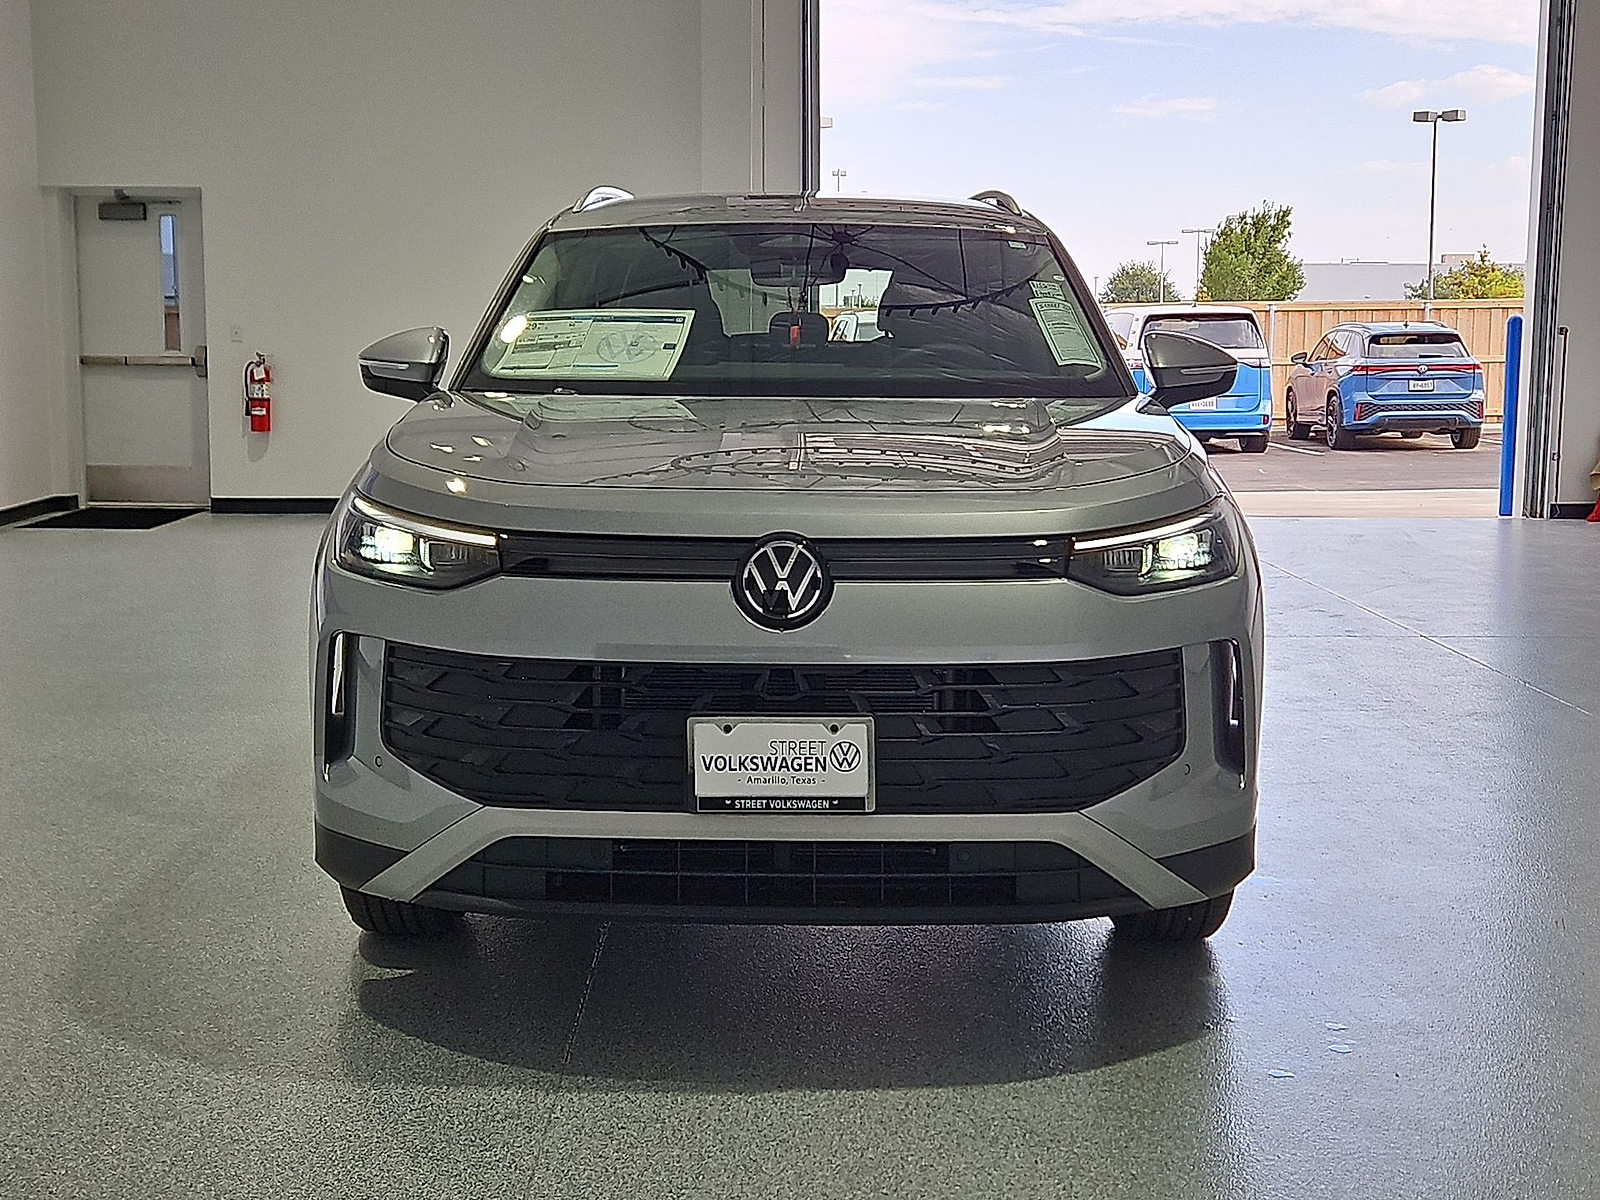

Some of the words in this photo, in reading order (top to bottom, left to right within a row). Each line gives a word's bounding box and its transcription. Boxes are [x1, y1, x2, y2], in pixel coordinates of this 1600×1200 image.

[769, 741, 827, 756] STREET
[701, 756, 827, 772] VOLKSWAGEN
[746, 775, 789, 786] Amarillo,
[791, 776, 817, 785] Texas
[734, 800, 767, 809] STREET
[769, 800, 830, 809] VOLKSWAGEN
